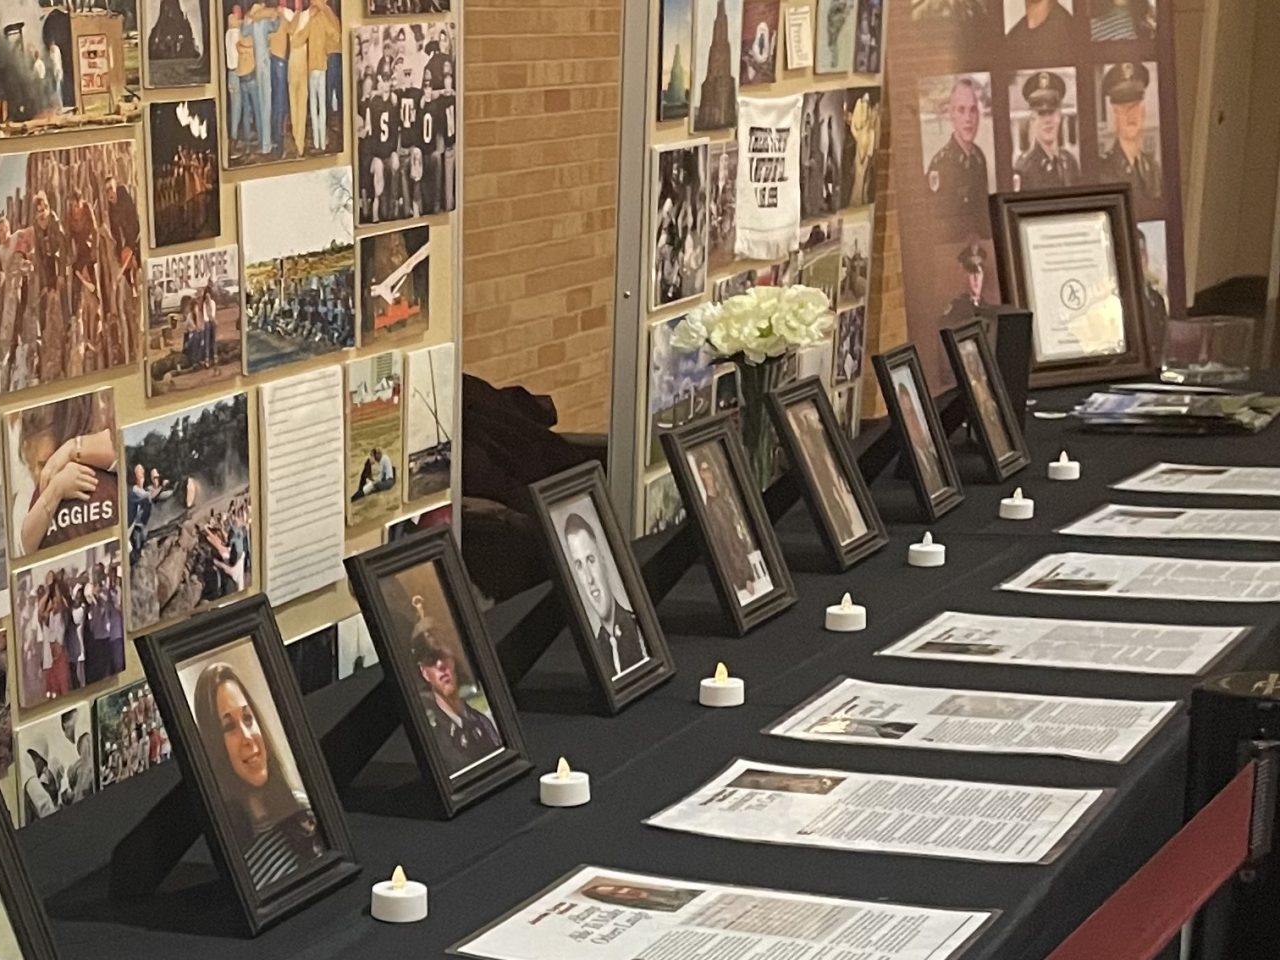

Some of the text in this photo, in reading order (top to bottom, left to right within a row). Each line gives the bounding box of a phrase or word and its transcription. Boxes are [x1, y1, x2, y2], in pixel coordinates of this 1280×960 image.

[380, 112, 389, 142] S
[165, 254, 191, 280] AGGIE
[47, 500, 113, 536] AGGIES
